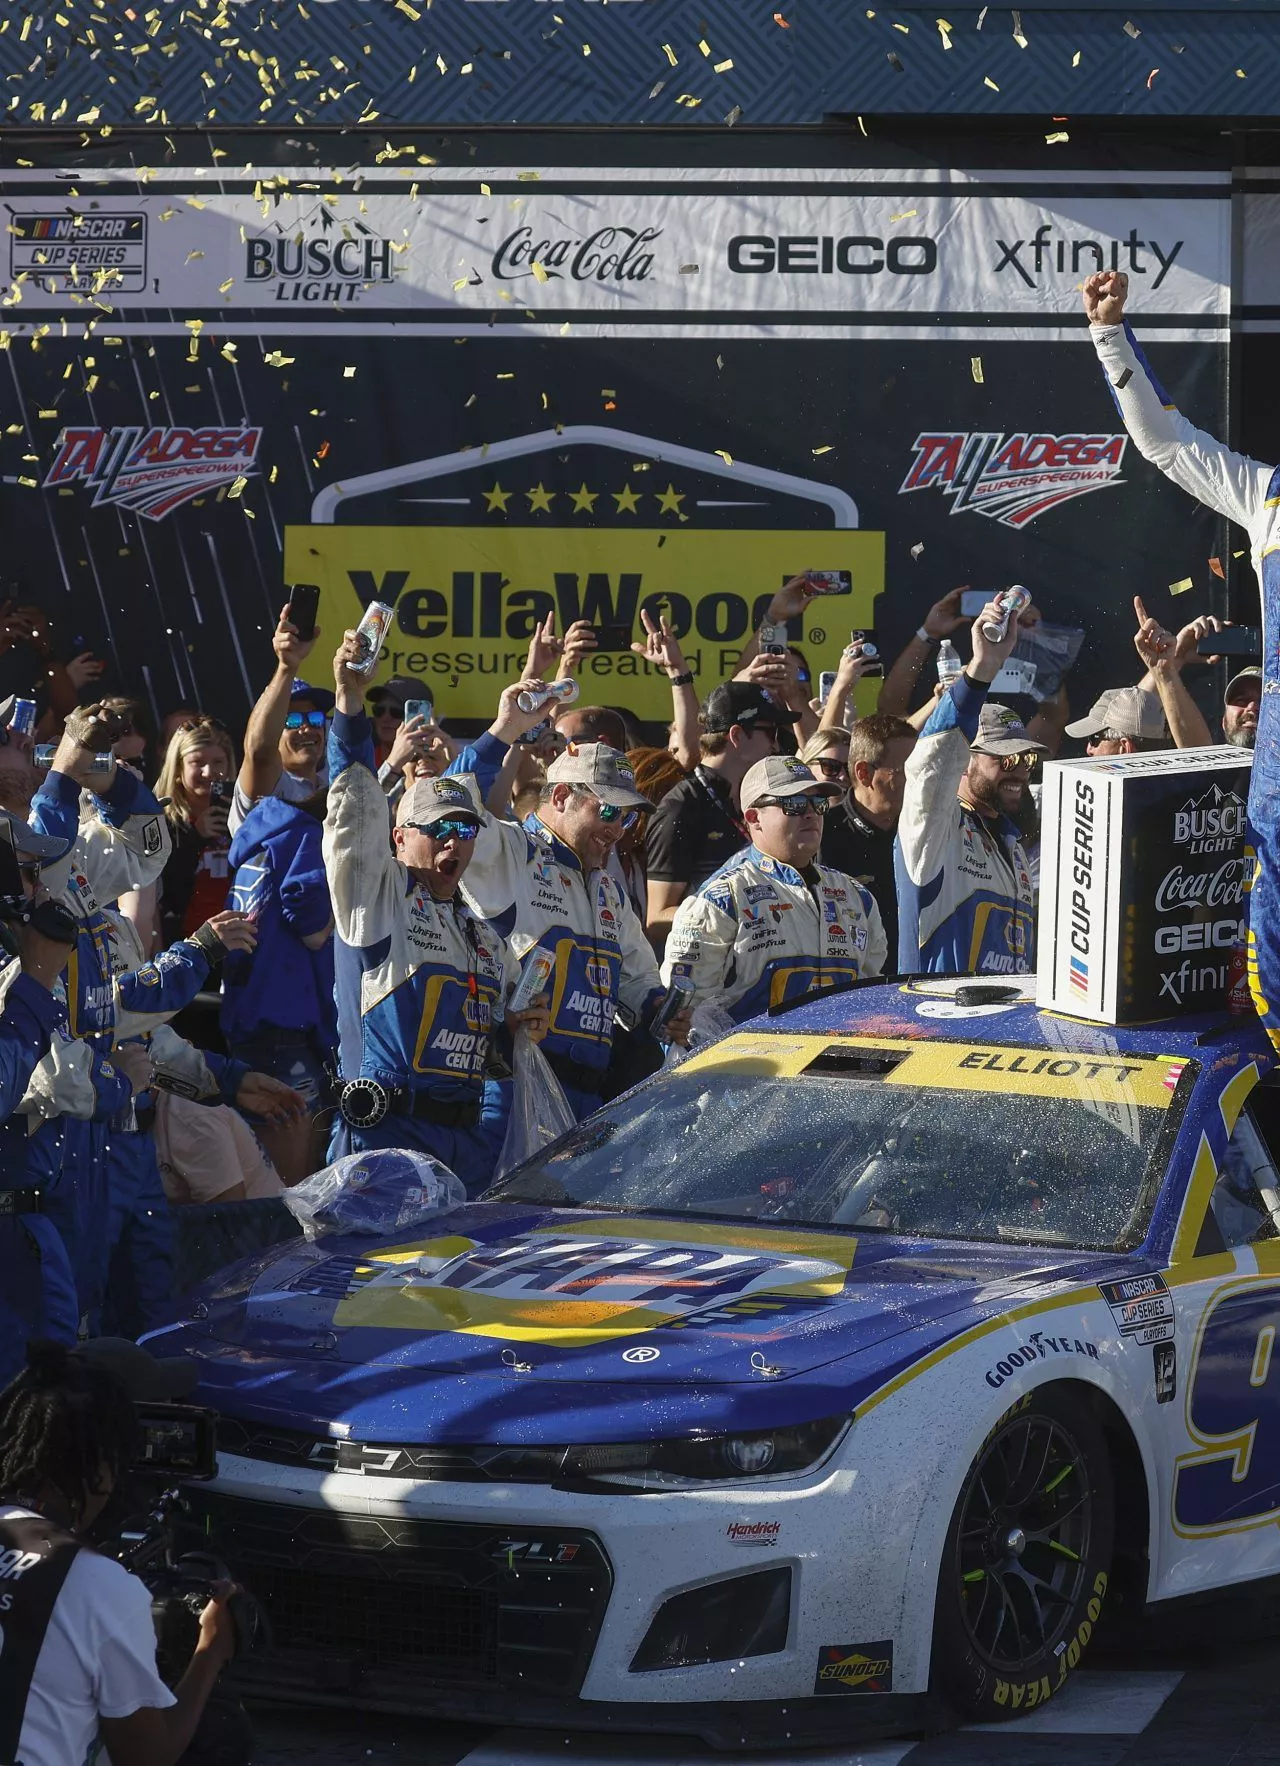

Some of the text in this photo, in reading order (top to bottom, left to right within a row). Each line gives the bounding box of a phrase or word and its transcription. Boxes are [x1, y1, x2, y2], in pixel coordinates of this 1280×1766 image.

[55, 219, 126, 238] NASCAR
[30, 247, 127, 265] CUP SERIES
[244, 237, 395, 283] BUSCH
[490, 226, 664, 284] Coca-Cola
[727, 234, 938, 275] GEICO
[993, 225, 1185, 290] xfinity
[64, 278, 125, 290] PLAYFFS
[274, 282, 359, 301] LIGHT
[44, 427, 263, 508] TALLADEGA
[115, 461, 251, 490] SUPERSPEEDWAY
[898, 432, 1129, 516] TALLADEGA
[973, 467, 1118, 496] SUPERSPEEDWAY
[1189, 838, 1236, 856] LIGHT
[1070, 779, 1095, 956] CUP SERIES
[1154, 858, 1245, 913] Coca-Co
[1159, 960, 1230, 1004] xfini
[956, 1052, 1143, 1083] ELLIOTT
[1122, 1278, 1157, 1299] NASCAR
[1121, 1300, 1165, 1322] CUP SERIES
[1143, 1326, 1167, 1341] PLAYOFFS
[985, 1331, 1101, 1389] GOODYEAR
[1157, 1350, 1176, 1394] 12
[727, 1521, 781, 1540] Hendrick
[492, 1541, 581, 1562] ZL1
[992, 1571, 1108, 1709] GOODYEAR
[820, 1660, 890, 1679] SUNOCO
